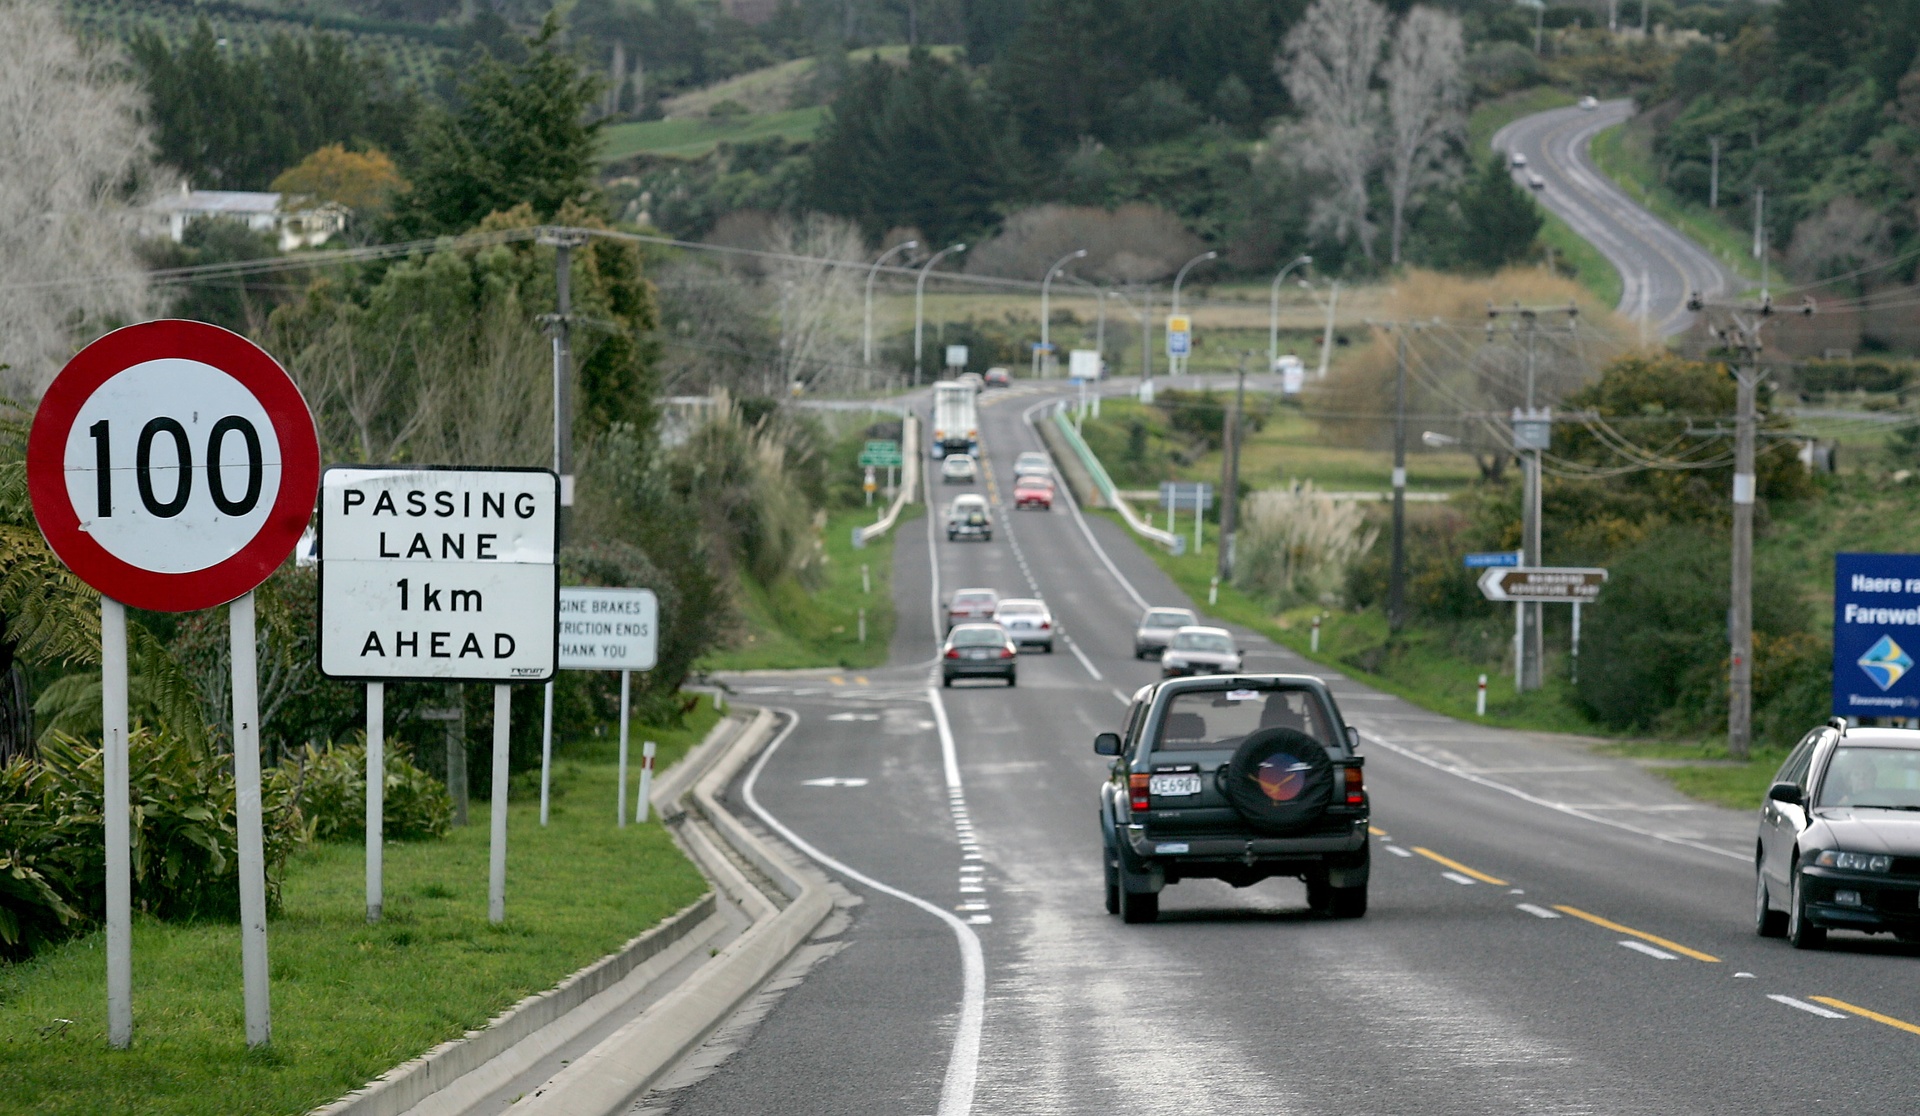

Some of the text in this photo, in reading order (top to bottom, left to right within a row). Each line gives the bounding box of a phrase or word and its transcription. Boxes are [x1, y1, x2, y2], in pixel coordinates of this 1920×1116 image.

[90, 415, 263, 518] 100
[343, 489, 535, 519] PASSING
[379, 532, 498, 560] LANE
[1851, 574, 1902, 593] Haere
[559, 600, 641, 614] GINE BRAKES
[616, 623, 648, 637] ENDS
[360, 631, 516, 659] AHEAD
[559, 643, 627, 659] HANK YOU
